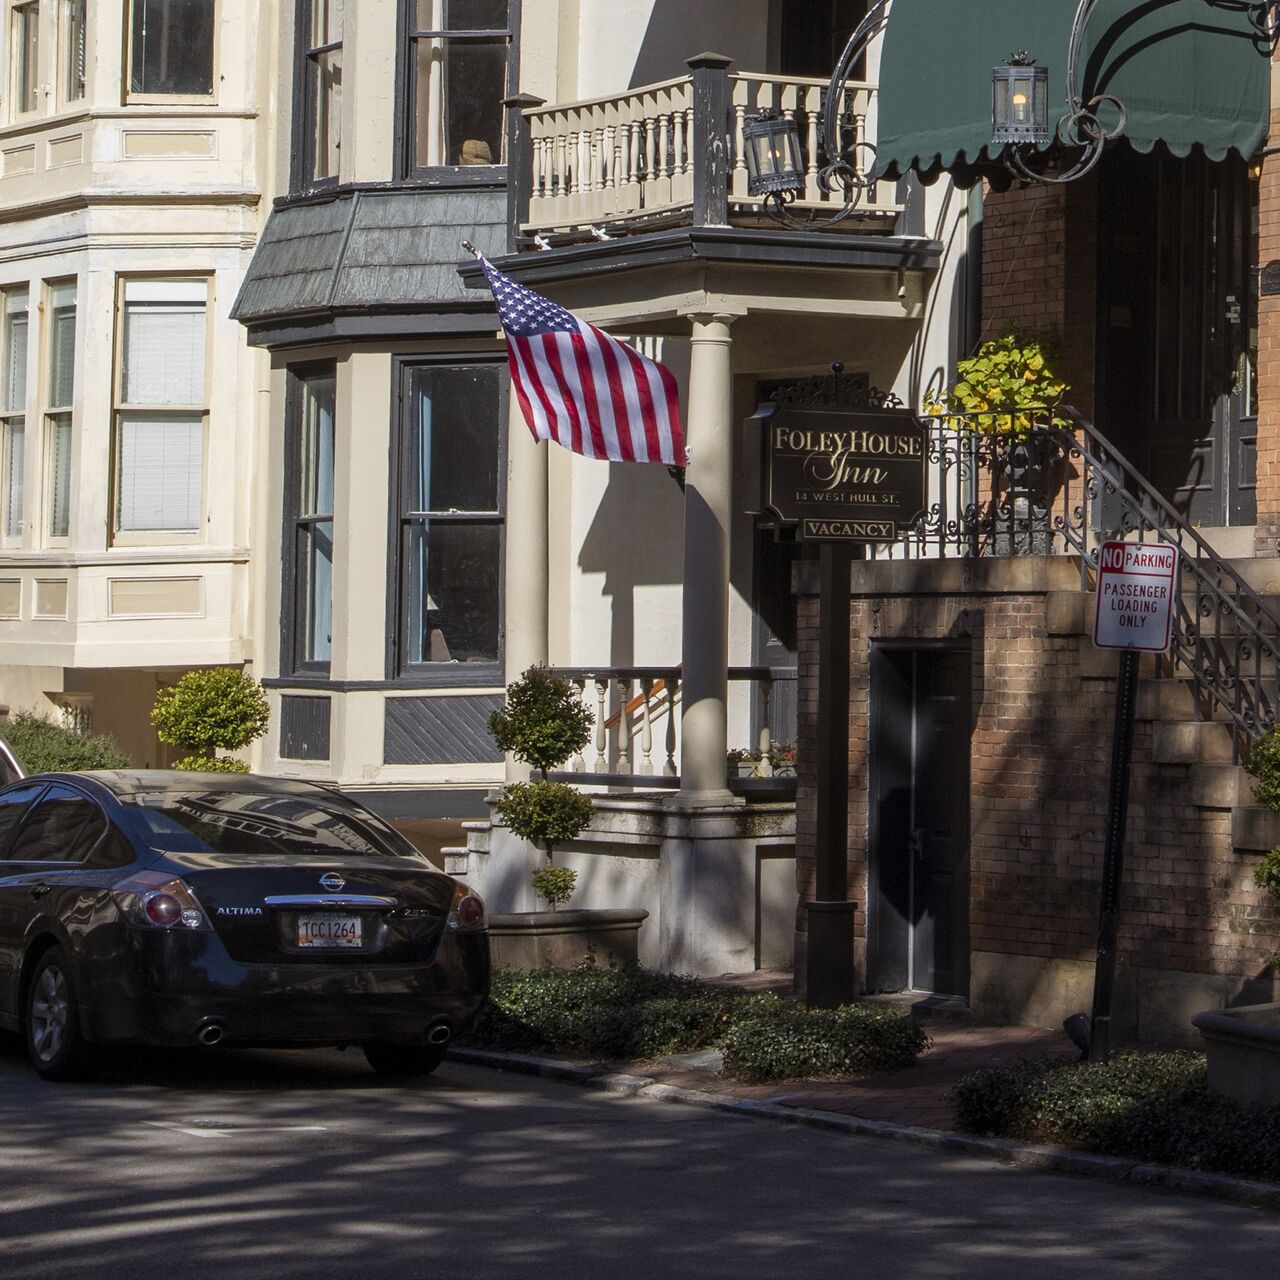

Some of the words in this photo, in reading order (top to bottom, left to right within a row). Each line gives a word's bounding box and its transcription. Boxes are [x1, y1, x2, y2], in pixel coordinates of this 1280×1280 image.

[775, 427, 848, 453] FOLEY
[849, 430, 922, 456] HOUSE
[803, 446, 888, 491] Inn
[795, 492, 808, 501] 14
[813, 492, 846, 502] WEST
[849, 493, 878, 503] HULL
[881, 494, 900, 504] ST.
[808, 521, 891, 537] VACANCY
[1102, 547, 1123, 569] NO
[1125, 552, 1172, 569] PARKING
[1104, 582, 1167, 599] PASSENGER
[1111, 598, 1157, 613] LOADING
[1119, 614, 1147, 628] ONLY
[216, 907, 263, 916] ALTIMA
